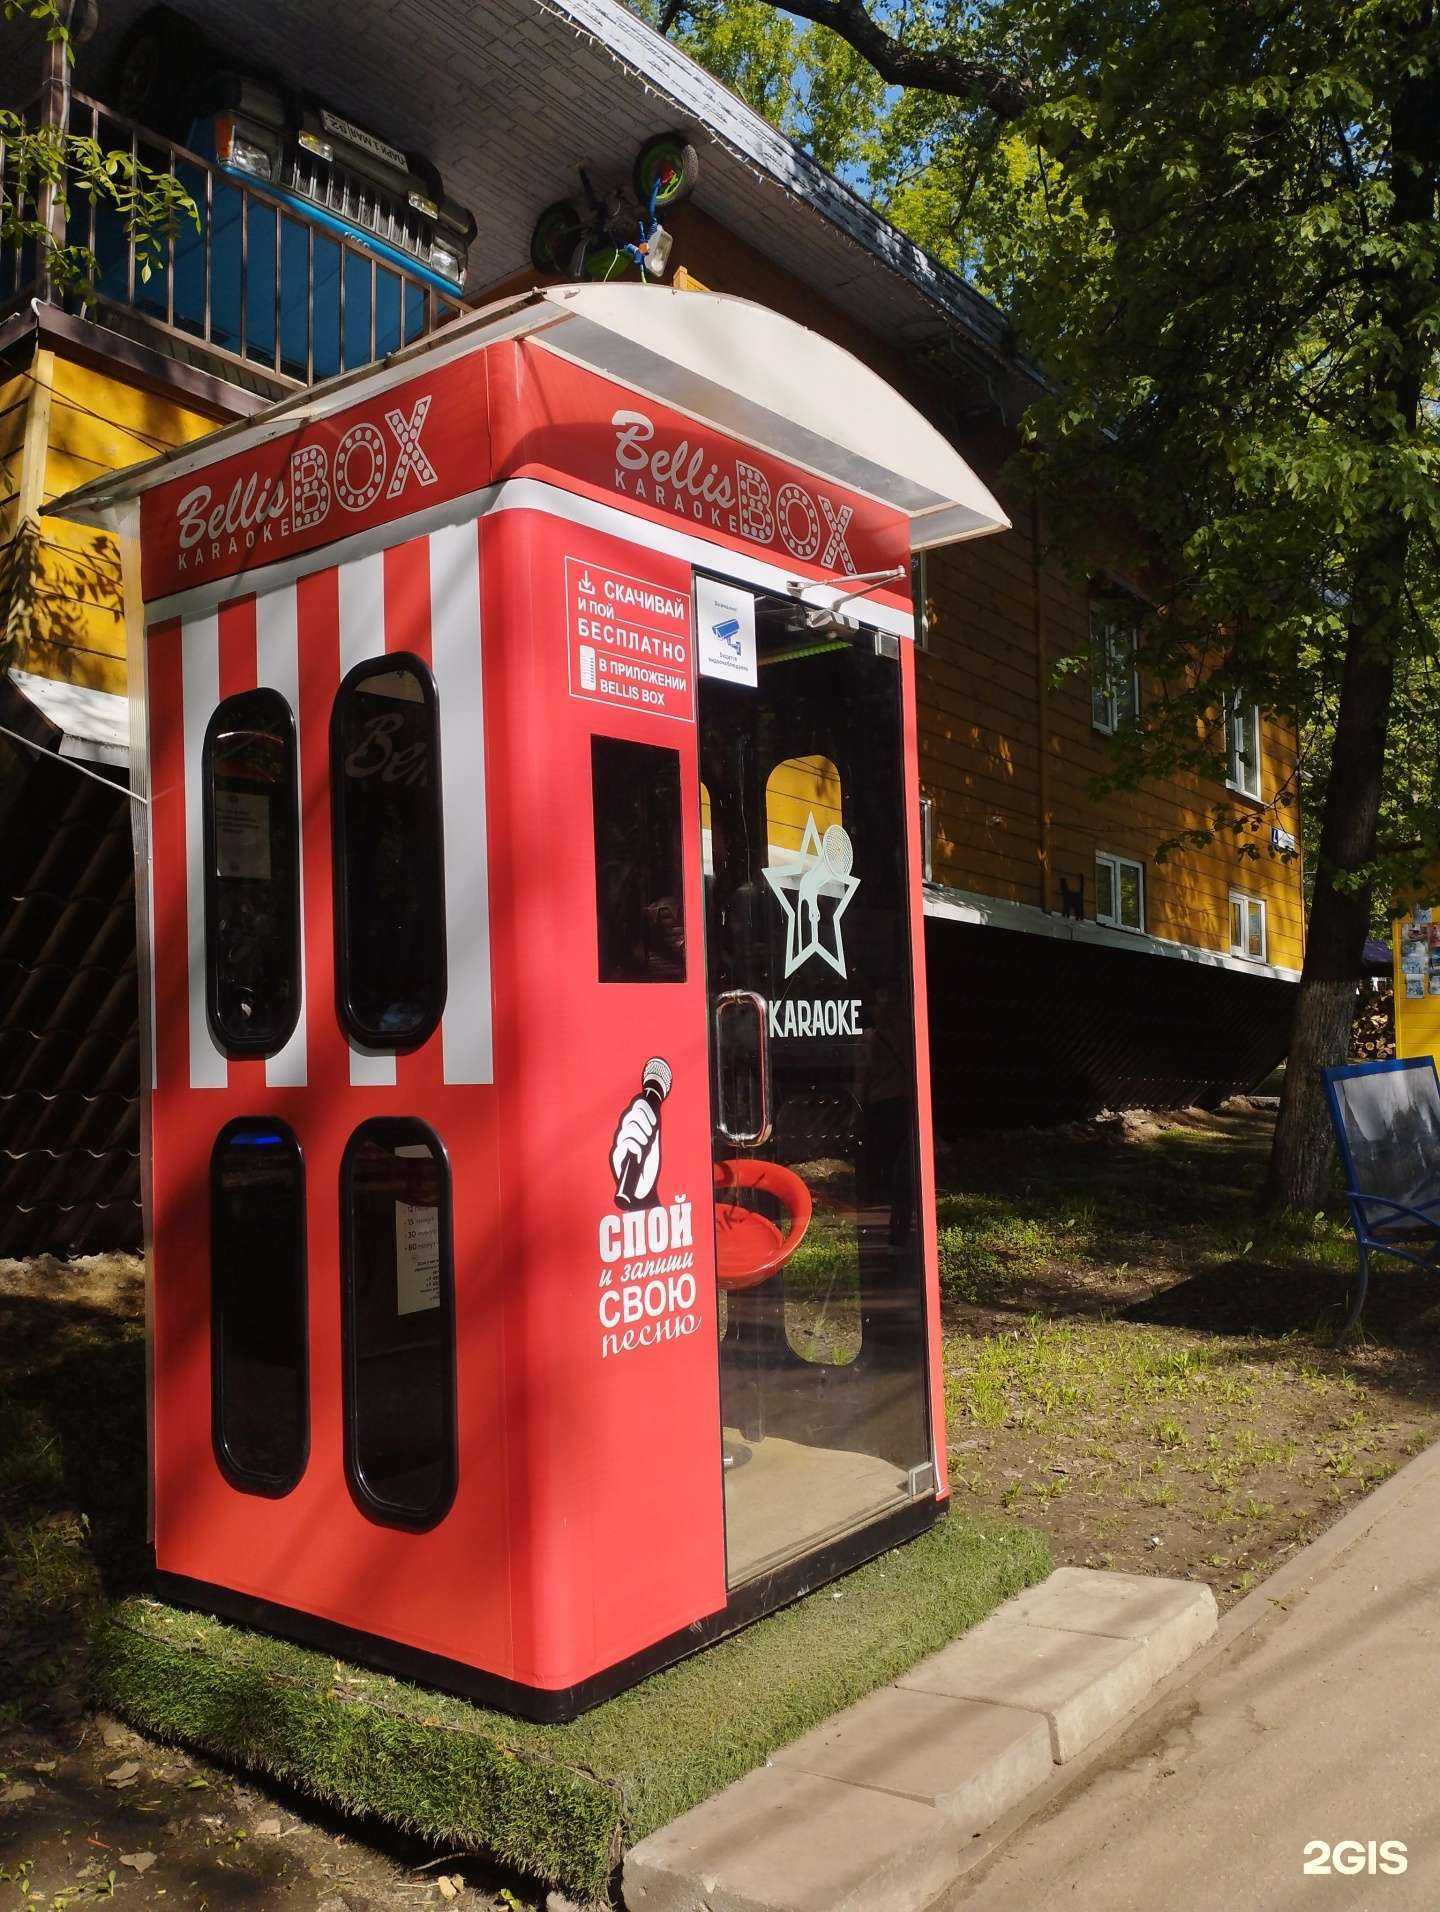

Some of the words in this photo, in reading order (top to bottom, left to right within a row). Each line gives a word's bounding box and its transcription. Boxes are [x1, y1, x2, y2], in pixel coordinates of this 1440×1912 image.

[177, 472, 289, 548] Bellis
[291, 395, 438, 532] BOX
[611, 410, 735, 509] Bellis
[736, 460, 857, 576] BOX
[615, 469, 737, 533] KARAOKE
[178, 518, 289, 570] KARAOKE
[578, 599, 587, 611] И
[590, 601, 615, 620] ПОЙ
[604, 580, 685, 620] СКАЧИВАЙ
[578, 618, 686, 662] БЕСПЛАТНО
[599, 658, 608, 672] В
[610, 661, 687, 691] ПРИЛОЖЕНИИ
[600, 681, 639, 700] BELLIS
[642, 689, 665, 706] BOX
[769, 1000, 864, 1038] KARAOKE
[599, 1194, 693, 1263] СПОЙ
[599, 1269, 613, 1287] и
[620, 1253, 693, 1282] запиши
[599, 1273, 696, 1328] СВОЮ
[601, 1313, 702, 1358] песню
